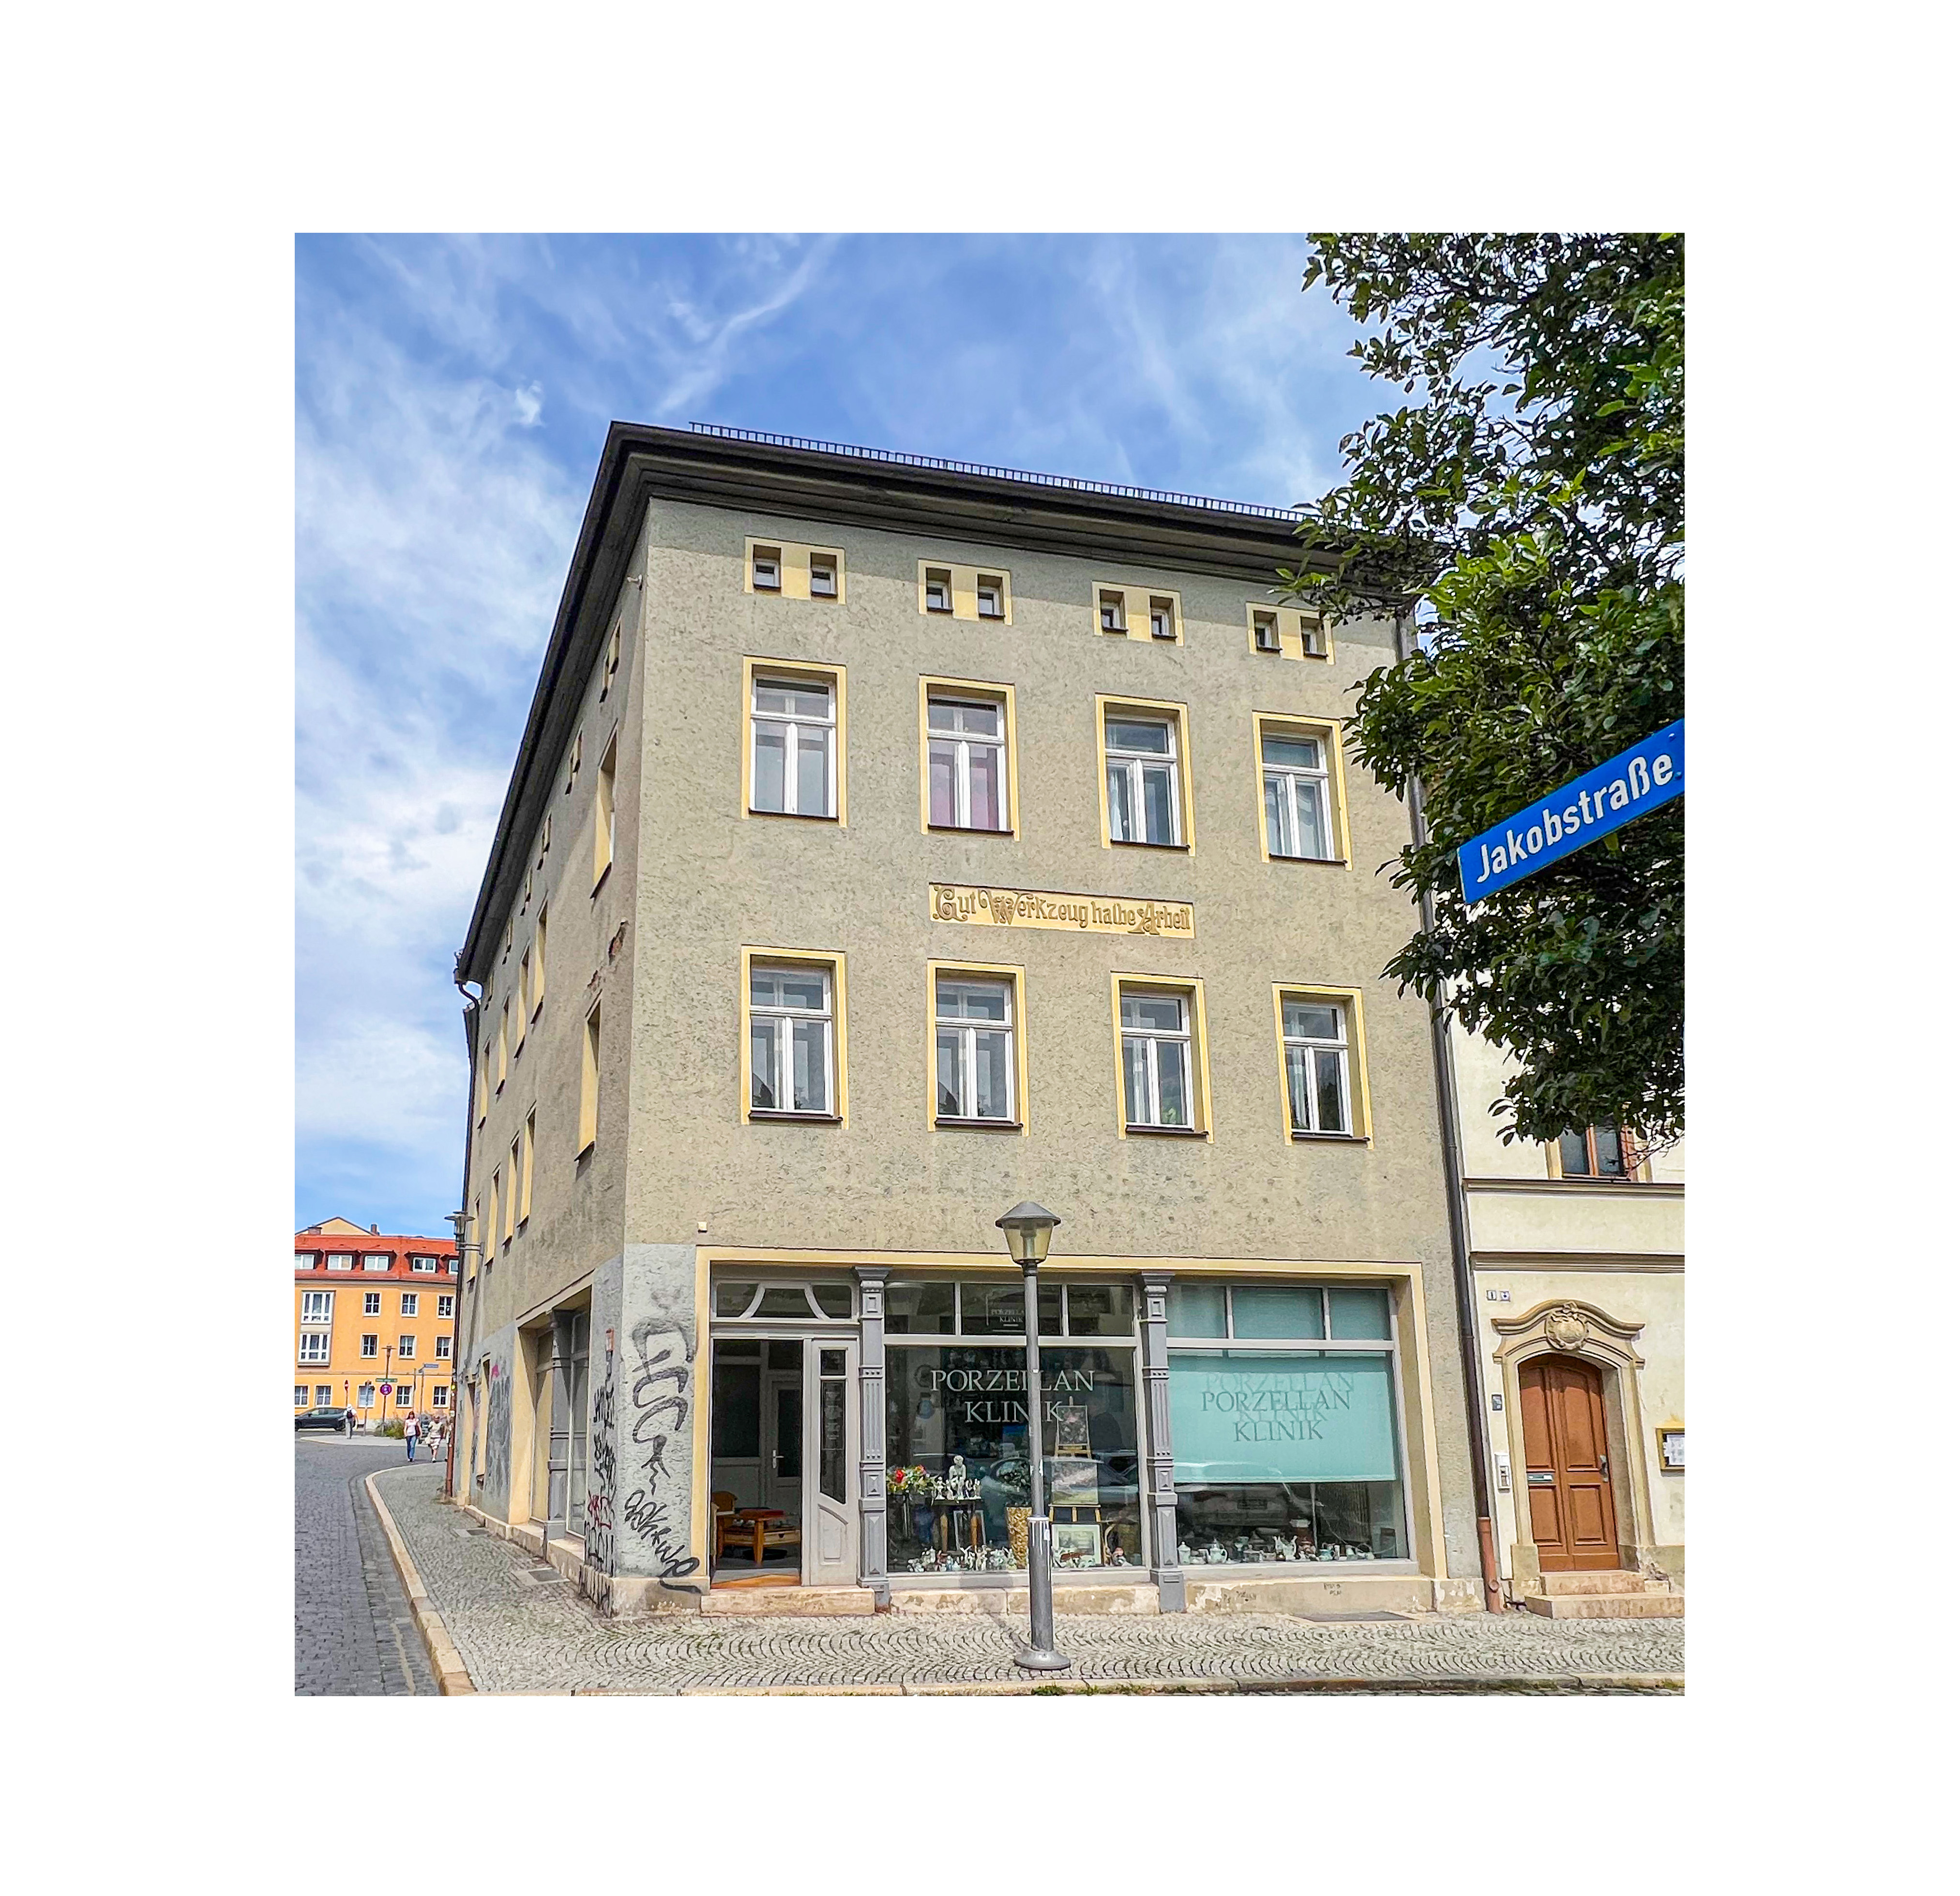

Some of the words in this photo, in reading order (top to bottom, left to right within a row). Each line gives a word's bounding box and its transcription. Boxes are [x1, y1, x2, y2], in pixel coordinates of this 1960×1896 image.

[1477, 754, 1673, 883] Jakobstraße
[932, 885, 977, 922] Gut
[978, 888, 1088, 928] Werkzeug
[1090, 901, 1136, 925] halbe
[1127, 902, 1190, 935] Arbeit
[965, 1400, 1064, 1423] KLINK
[1201, 1390, 1350, 1412] PORZELLAN
[1233, 1420, 1323, 1442] KLINIK
